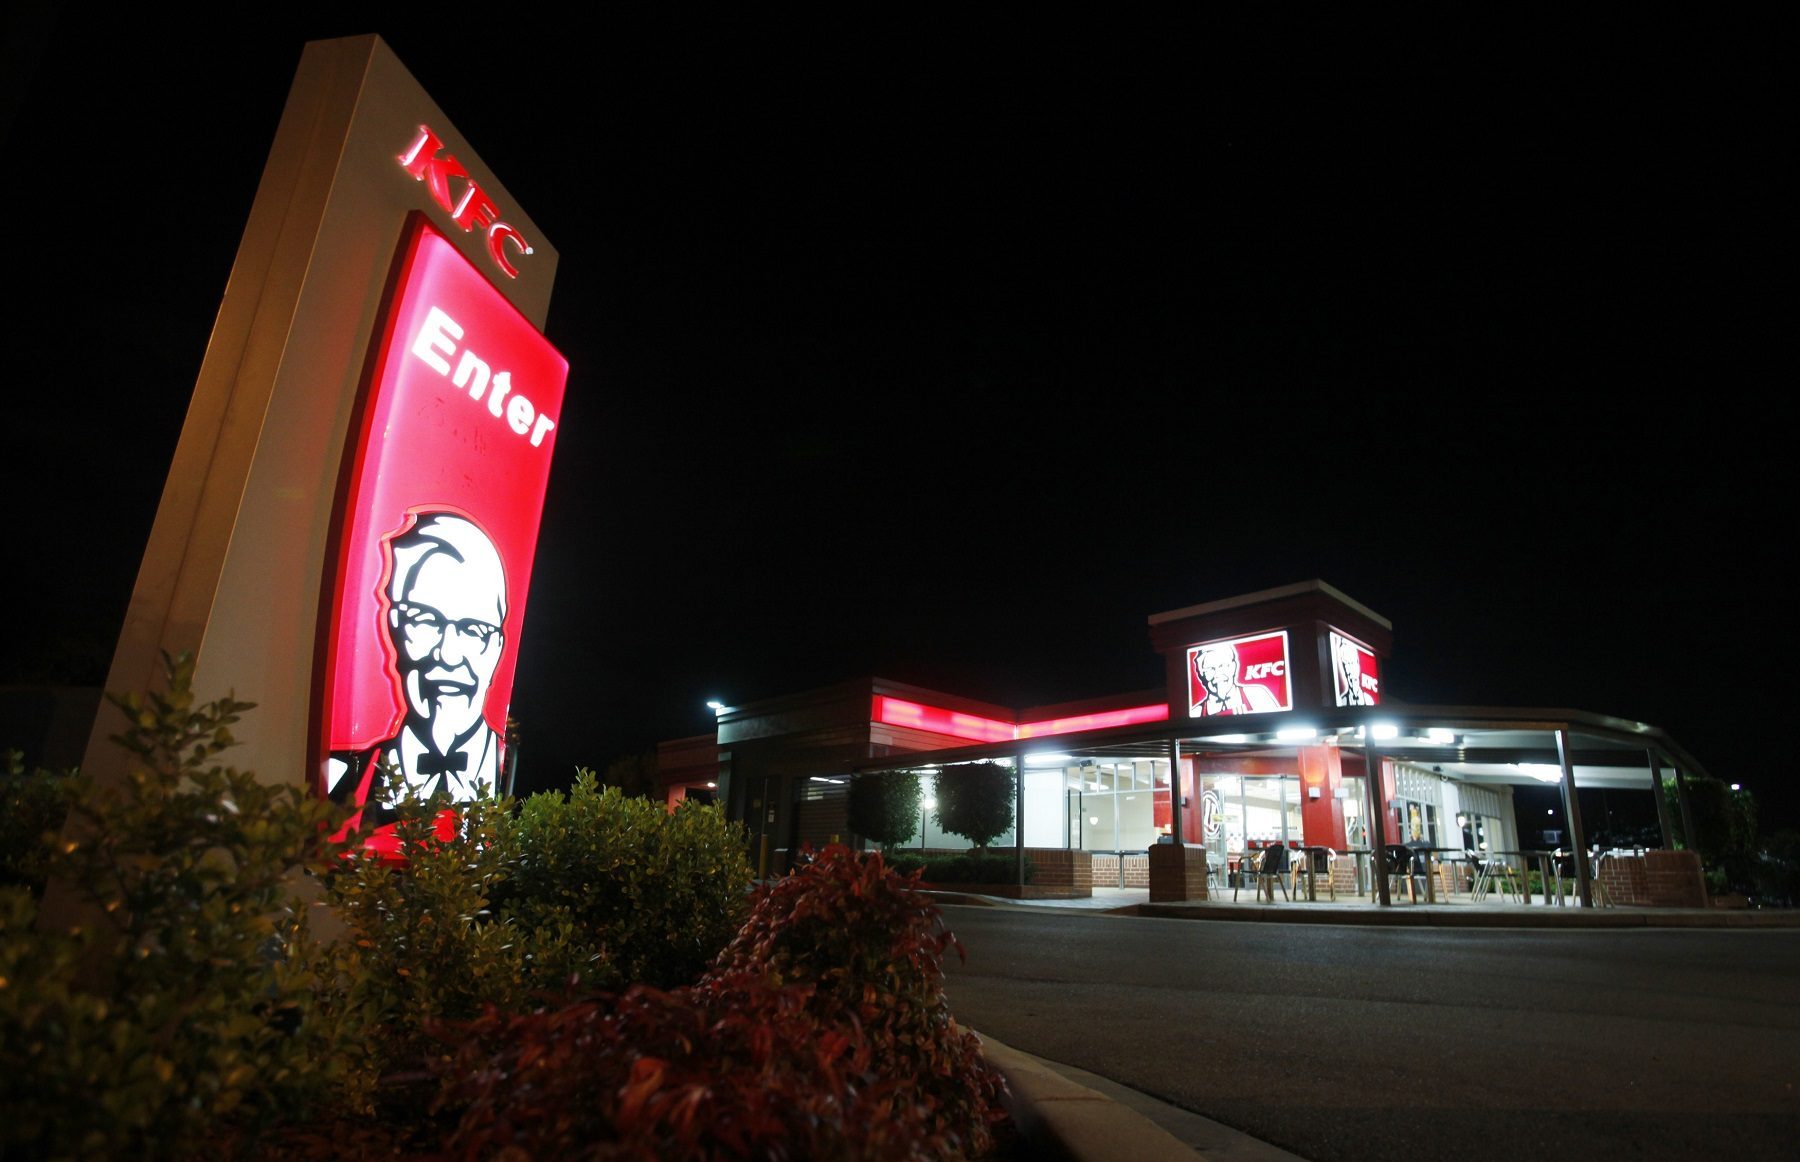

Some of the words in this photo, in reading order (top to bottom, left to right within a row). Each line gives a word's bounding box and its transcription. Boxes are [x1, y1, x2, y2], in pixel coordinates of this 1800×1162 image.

[398, 124, 534, 278] KFC
[412, 306, 555, 447] Enter
[1245, 660, 1285, 680] KFC
[1361, 673, 1378, 692] KFC
